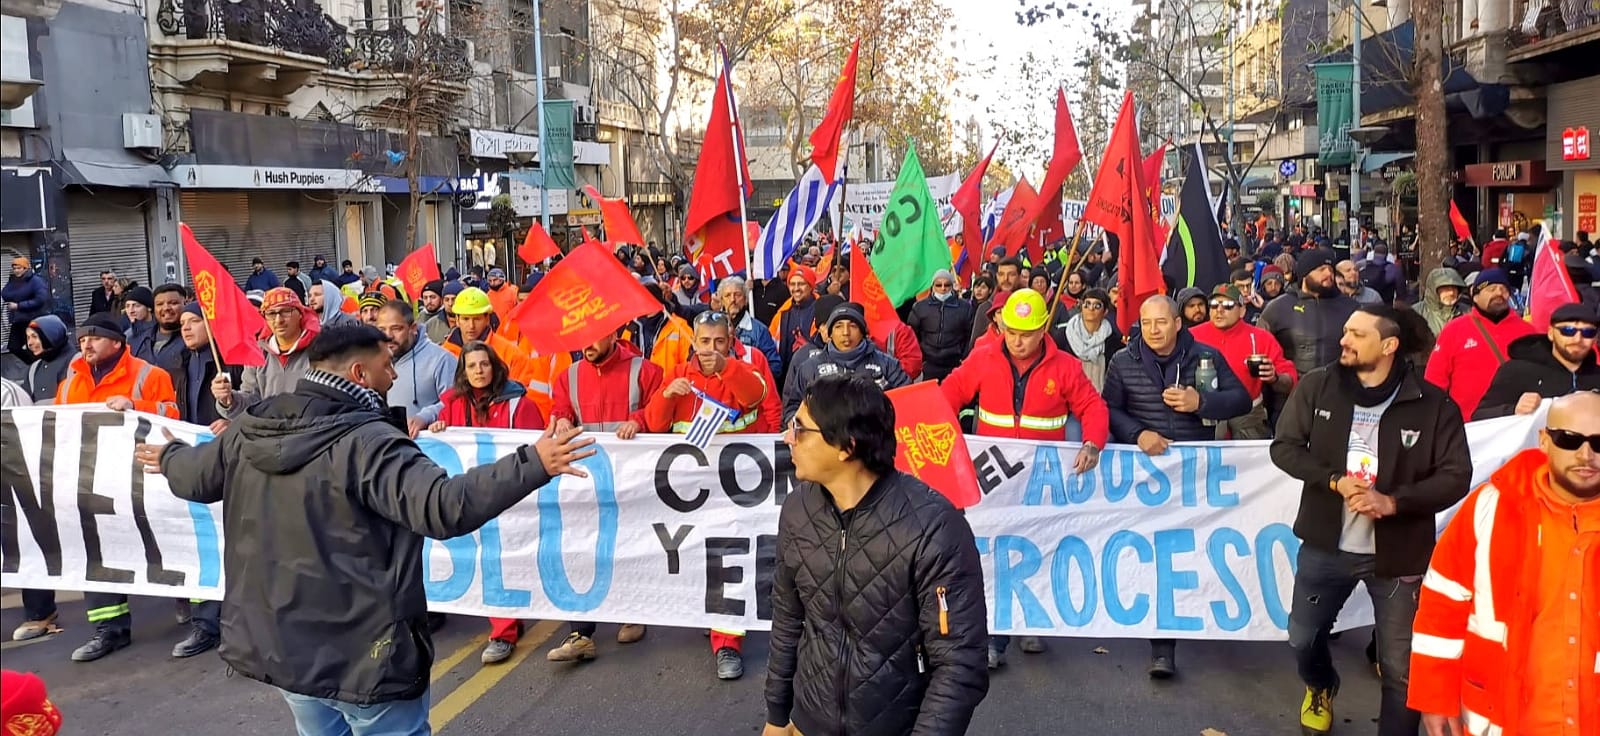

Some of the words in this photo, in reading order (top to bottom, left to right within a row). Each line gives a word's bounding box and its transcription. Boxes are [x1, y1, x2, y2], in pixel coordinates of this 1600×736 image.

[265, 171, 289, 184] Hush
[291, 172, 325, 186] Puppies
[1492, 164, 1516, 180] FORUM
[900, 426, 926, 469] SUNCA
[972, 445, 1025, 495] EL
[1021, 445, 1240, 508] AJUSTE
[652, 522, 695, 574] Y
